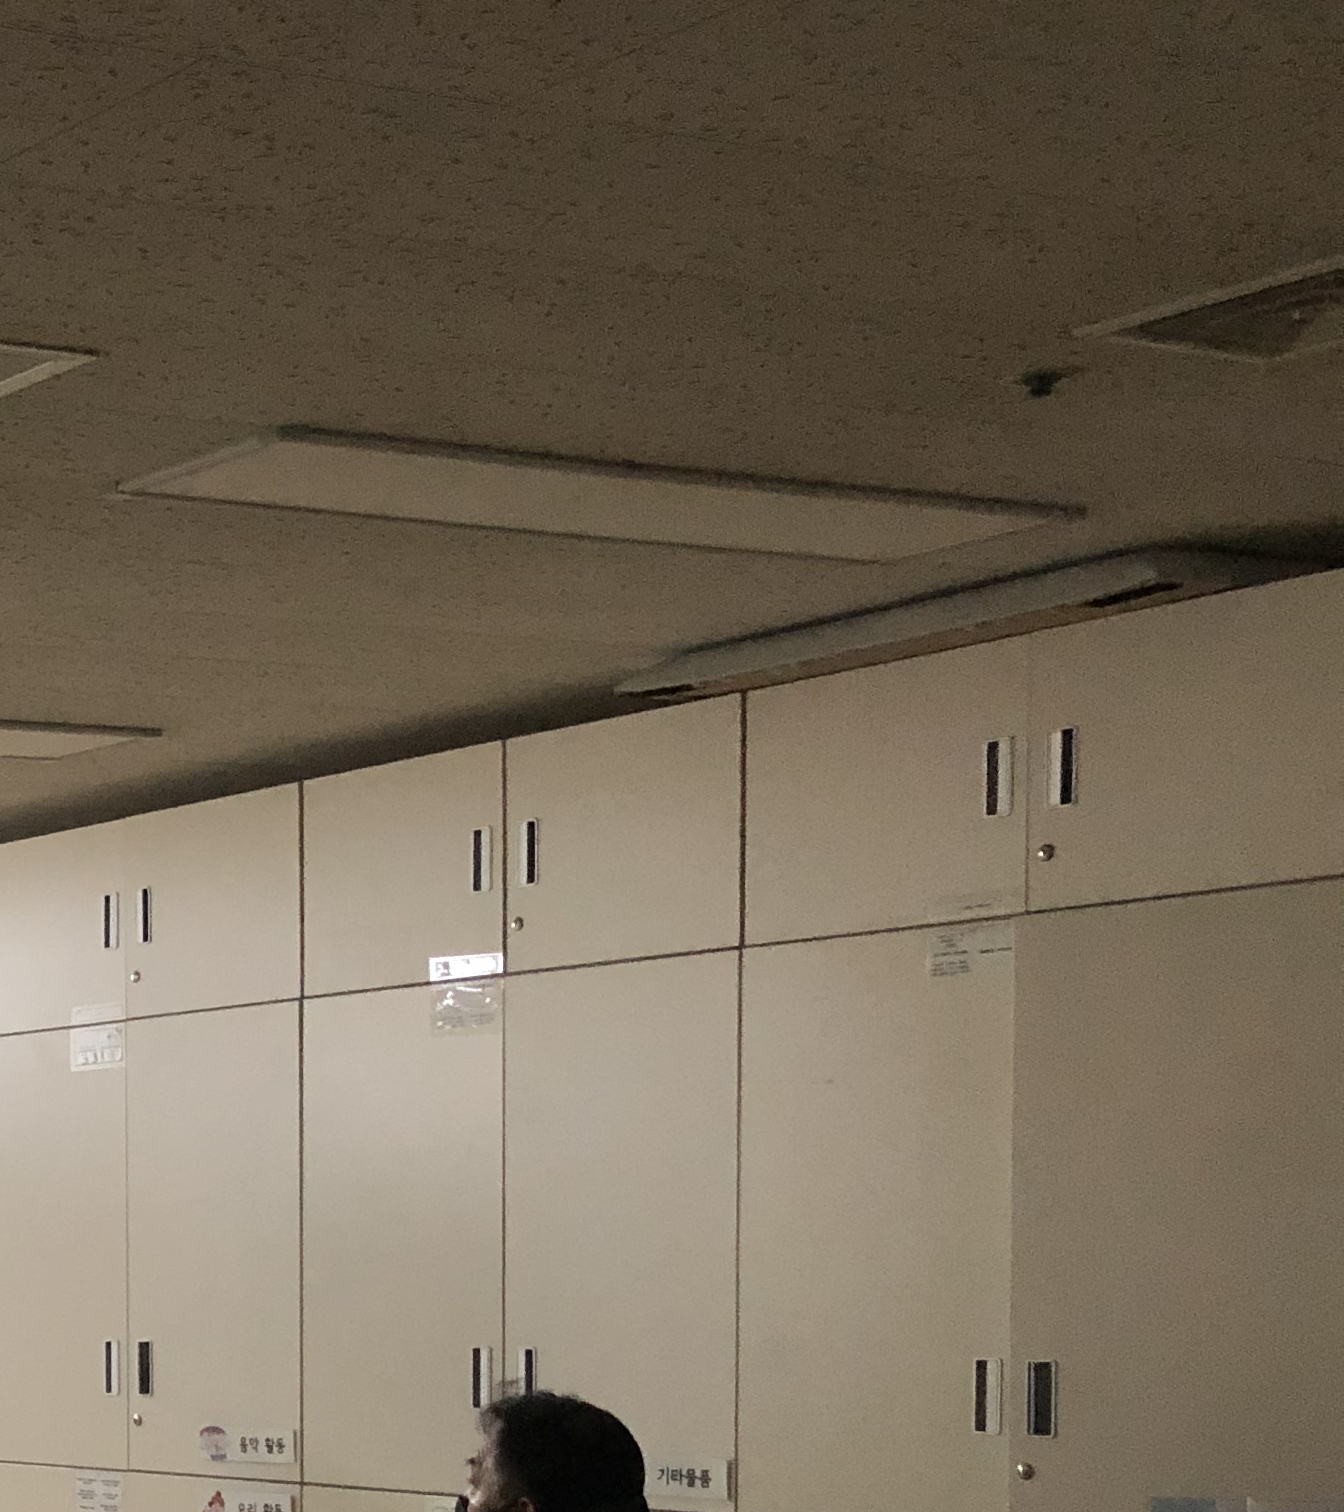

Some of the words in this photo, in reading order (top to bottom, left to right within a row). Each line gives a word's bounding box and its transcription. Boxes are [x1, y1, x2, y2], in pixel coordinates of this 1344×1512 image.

[238, 1436, 260, 1453] 음악
[264, 1437, 286, 1455] 활동
[656, 1465, 712, 1489] 기타물품
